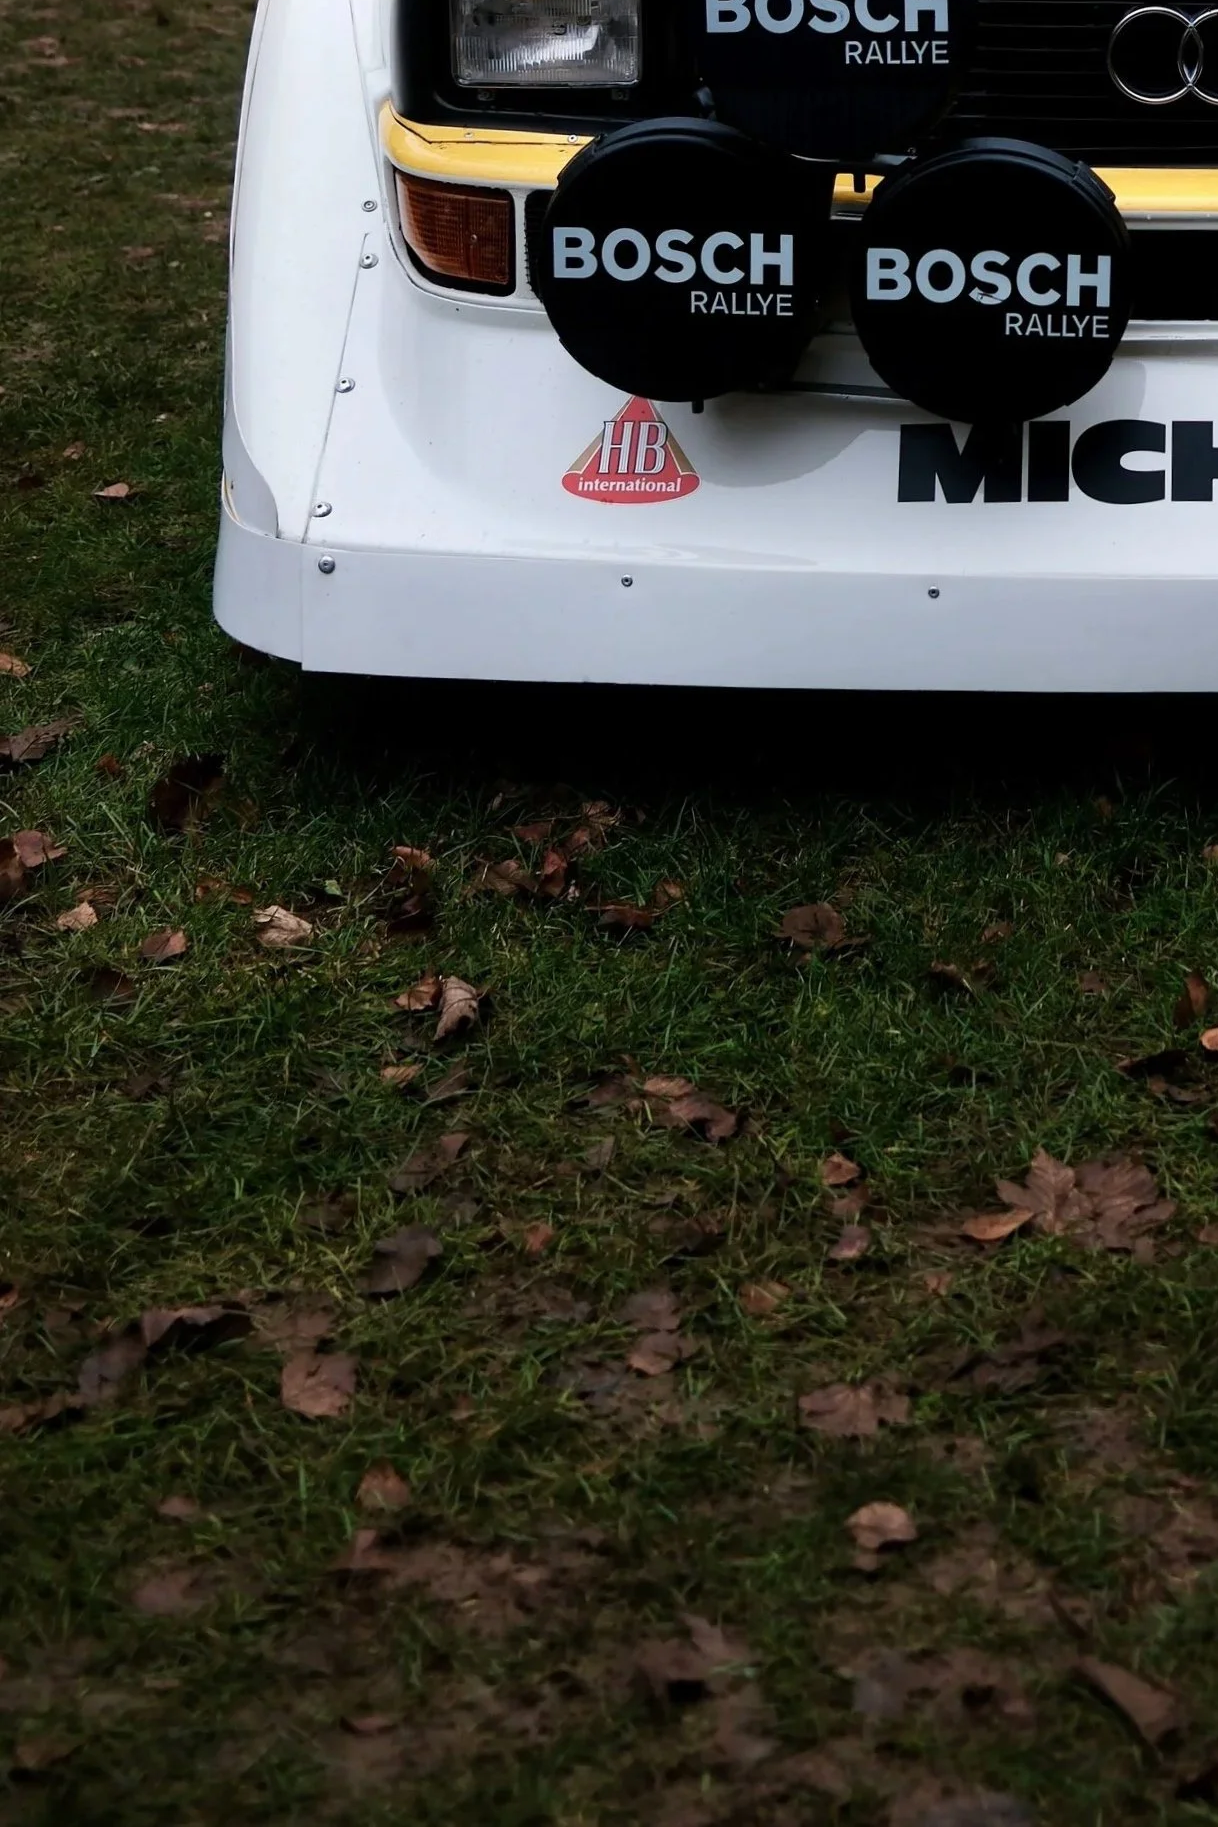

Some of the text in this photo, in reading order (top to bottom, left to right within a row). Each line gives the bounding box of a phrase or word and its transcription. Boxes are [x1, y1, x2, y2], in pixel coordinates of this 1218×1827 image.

[845, 40, 949, 65] RALLYE
[553, 226, 794, 285] BOSCH
[866, 248, 1111, 308] BOSCH
[690, 290, 793, 316] RALLYE
[1005, 312, 1109, 339] RALLYE
[599, 421, 669, 475] HB
[578, 477, 682, 493] international
